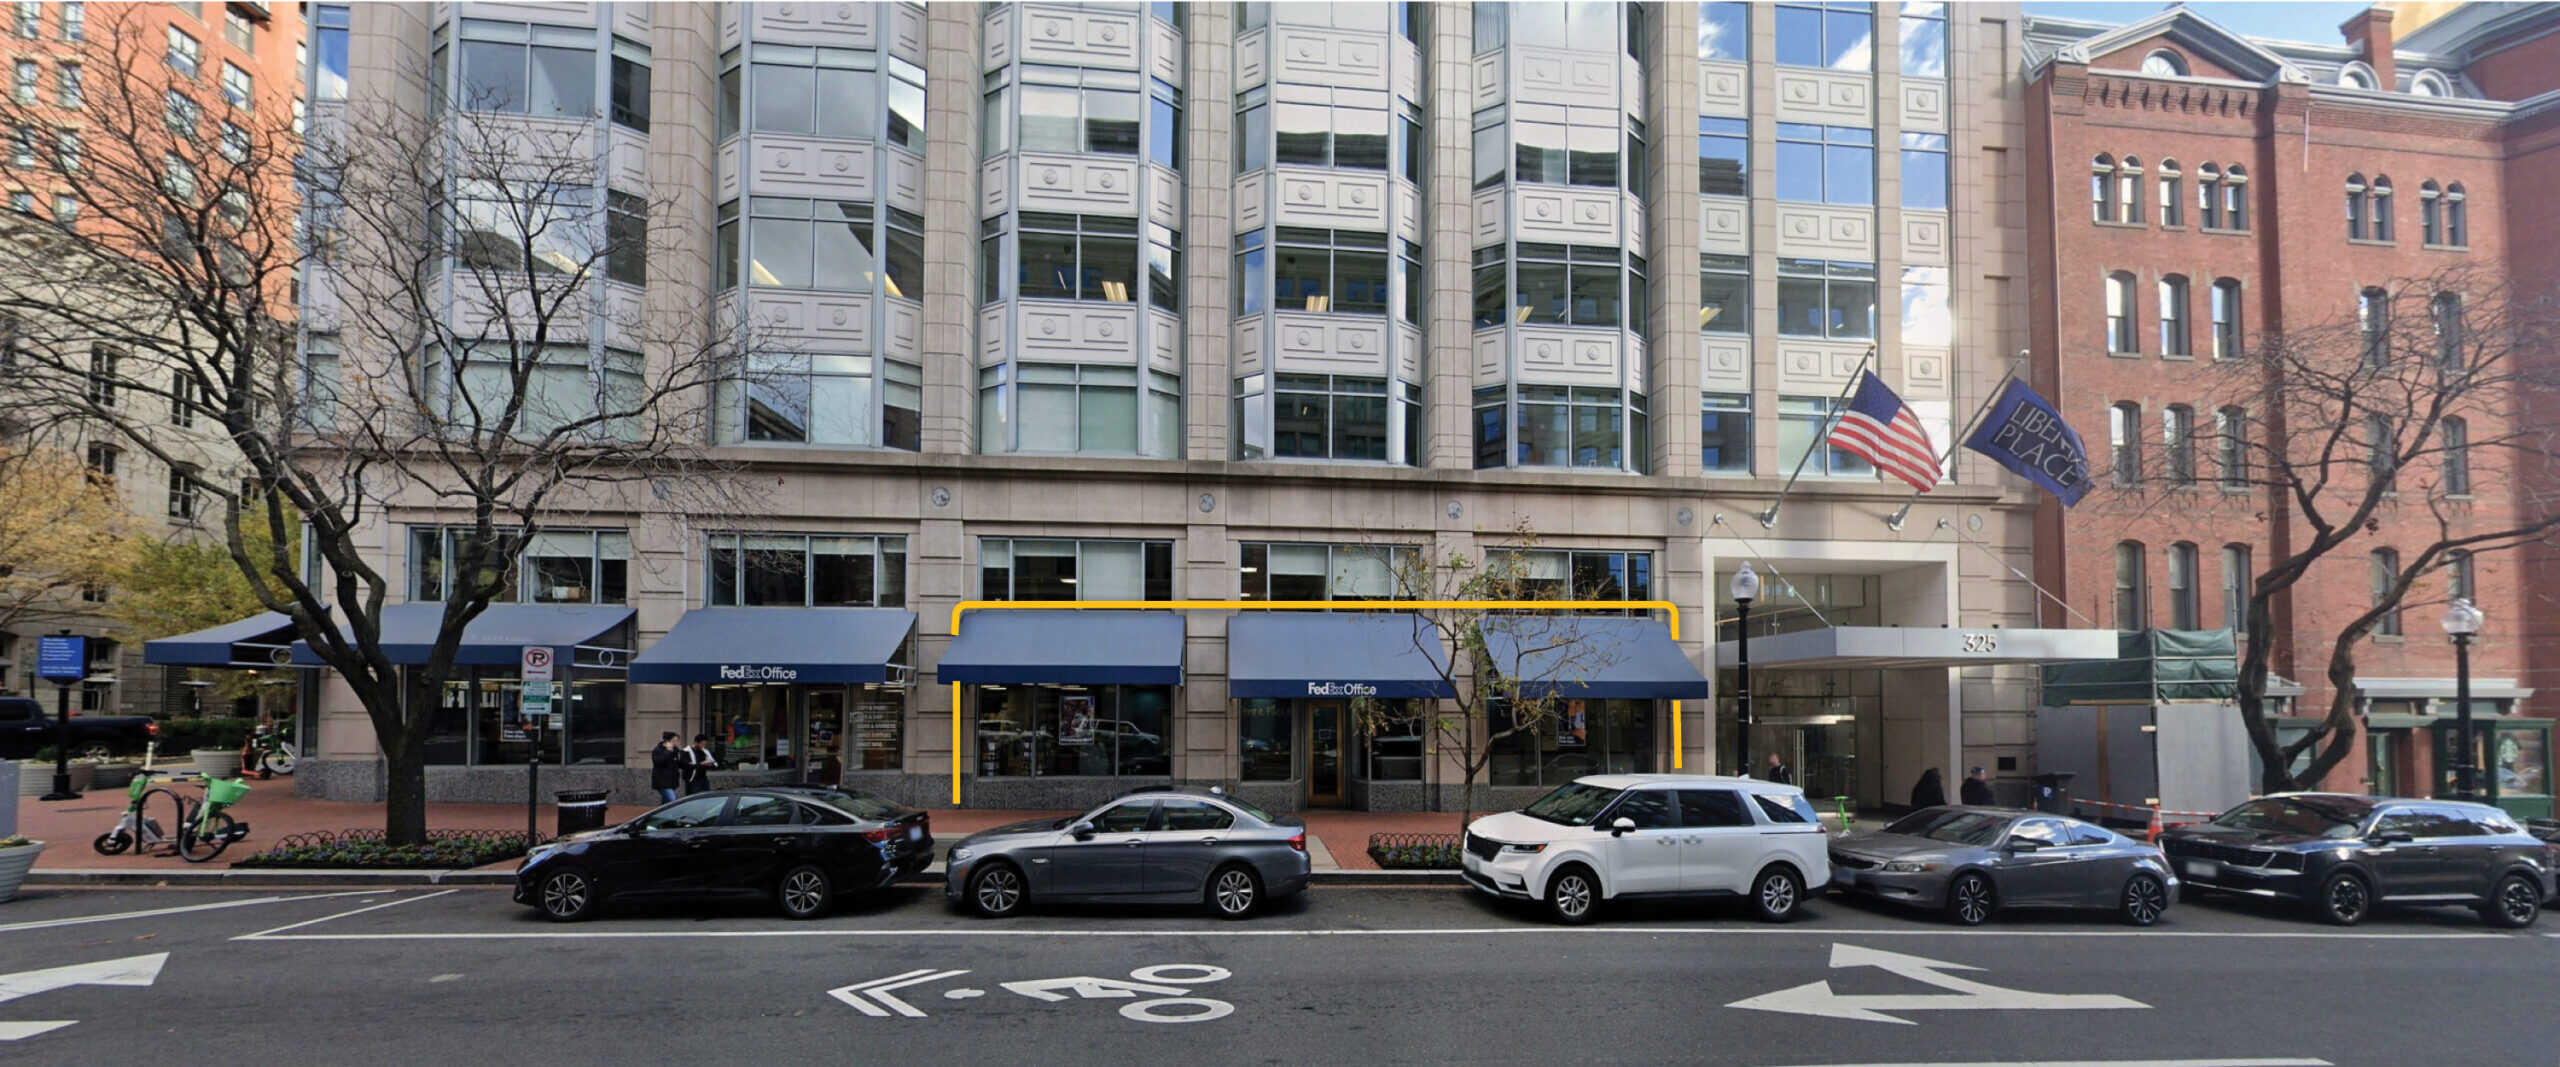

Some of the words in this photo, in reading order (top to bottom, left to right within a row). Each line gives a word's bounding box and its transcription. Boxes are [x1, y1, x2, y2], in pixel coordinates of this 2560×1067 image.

[2010, 401, 2081, 462] LIBE
[1994, 423, 2077, 486] PLACE
[1964, 633, 1997, 651] 325
[761, 666, 797, 679] Office
